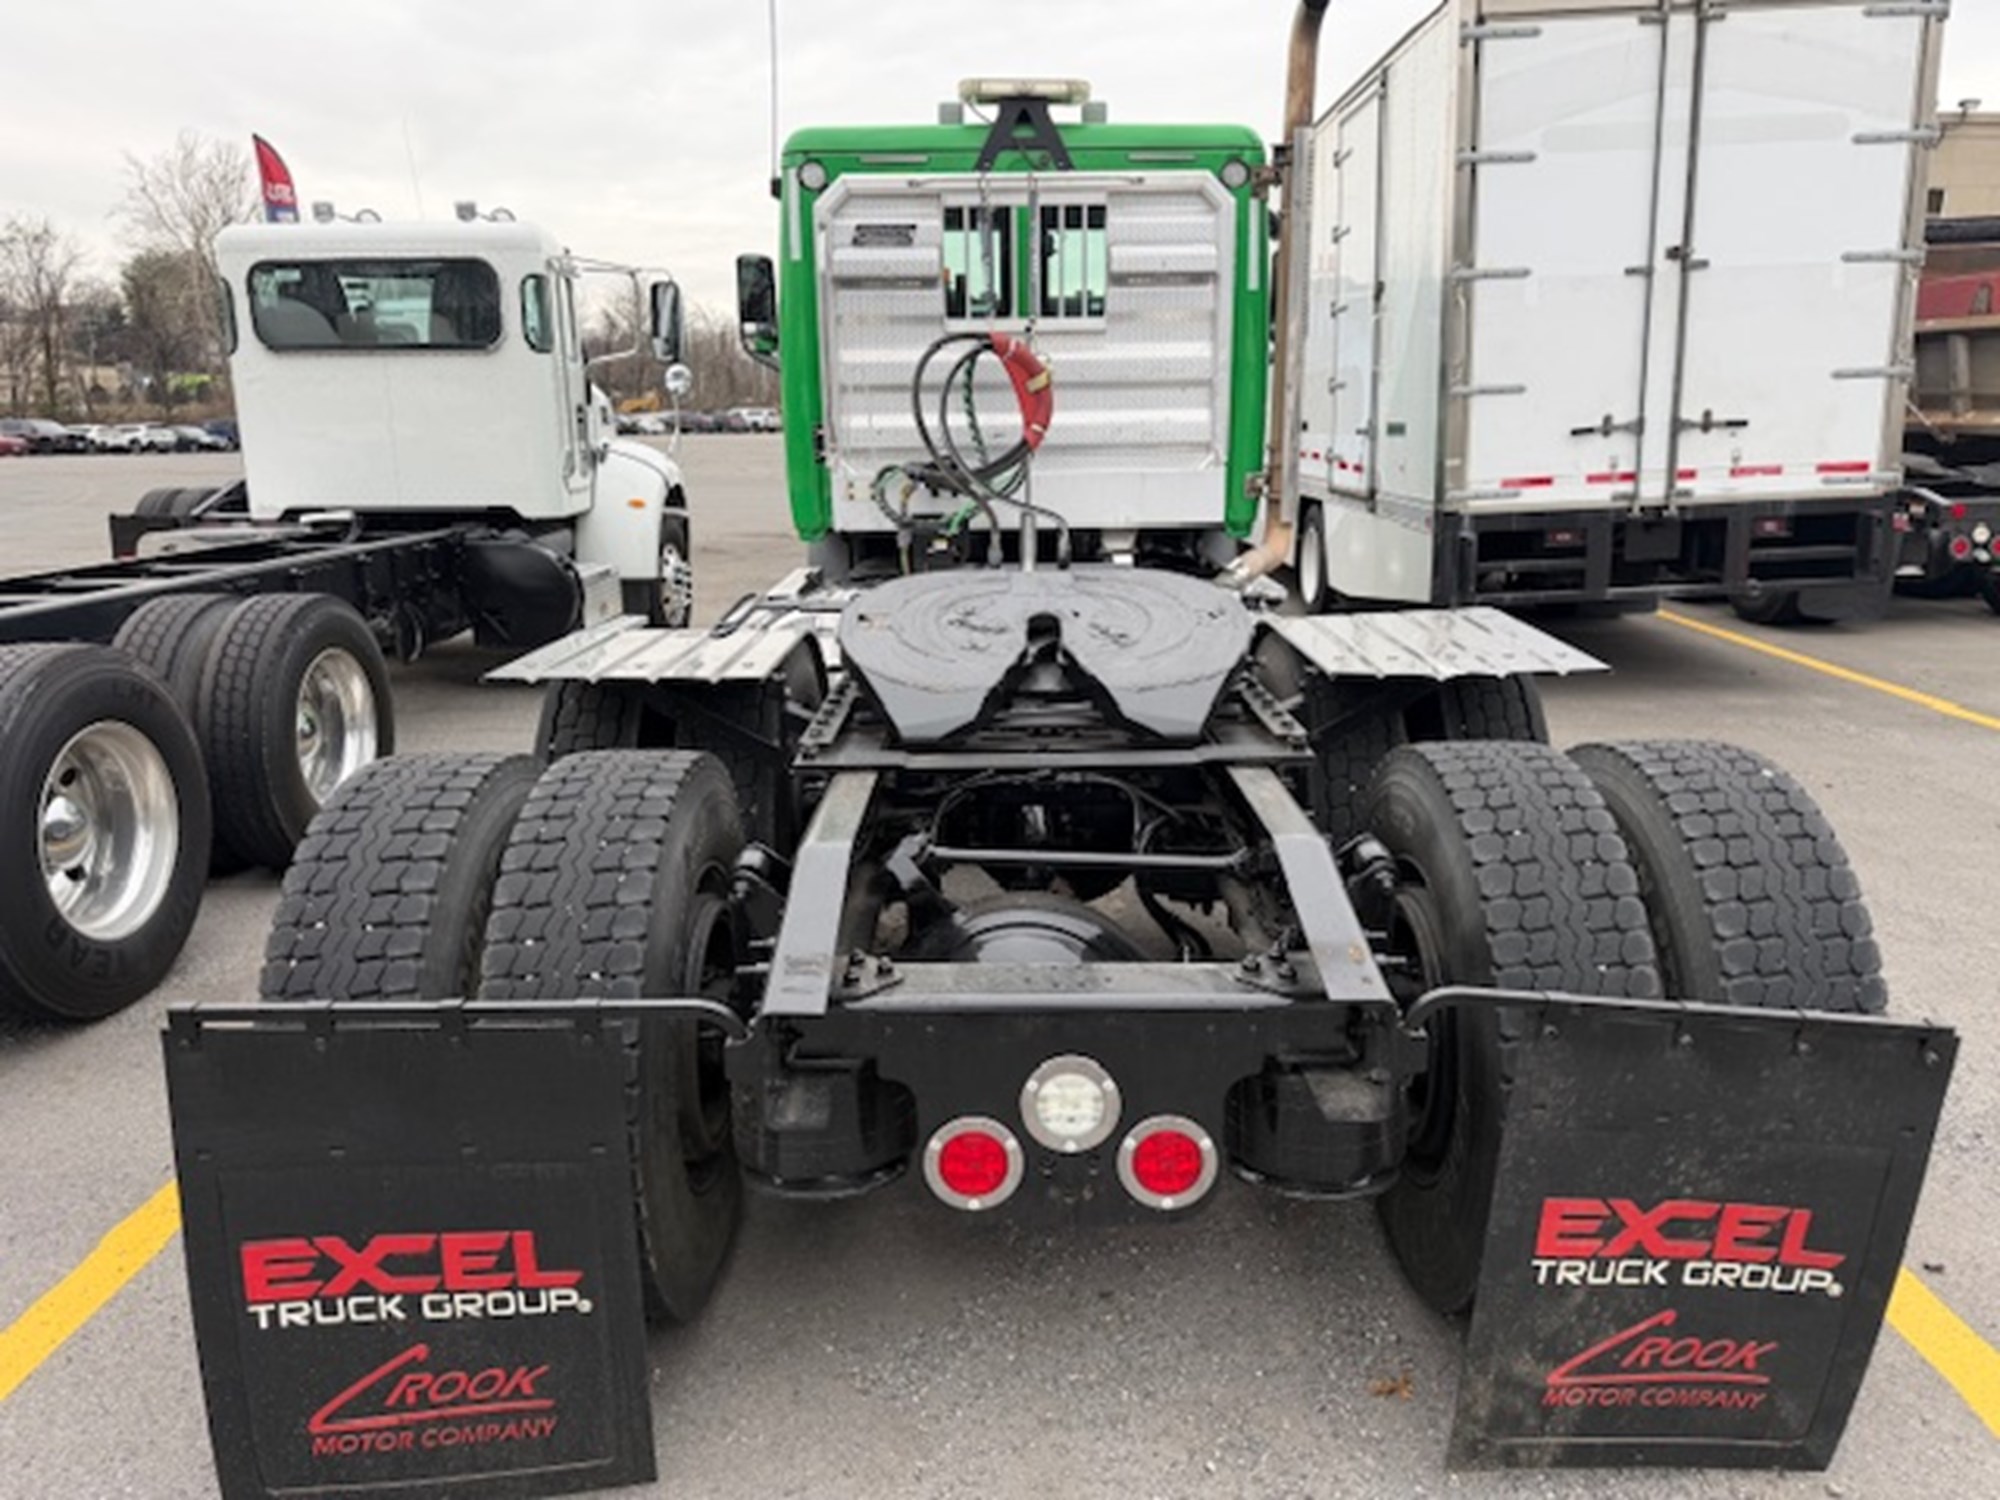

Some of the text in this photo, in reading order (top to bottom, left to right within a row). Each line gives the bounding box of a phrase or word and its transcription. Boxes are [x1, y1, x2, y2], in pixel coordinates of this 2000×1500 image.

[1533, 1198, 1846, 1268] EXCEL
[240, 1230, 584, 1302] EXCEL
[1532, 1259, 1668, 1286] TRUCK
[247, 1295, 408, 1331] TRUCK
[1542, 1386, 1766, 1410] MOTOR COMPANY
[311, 1417, 558, 1457] MOTOR COMPANY
